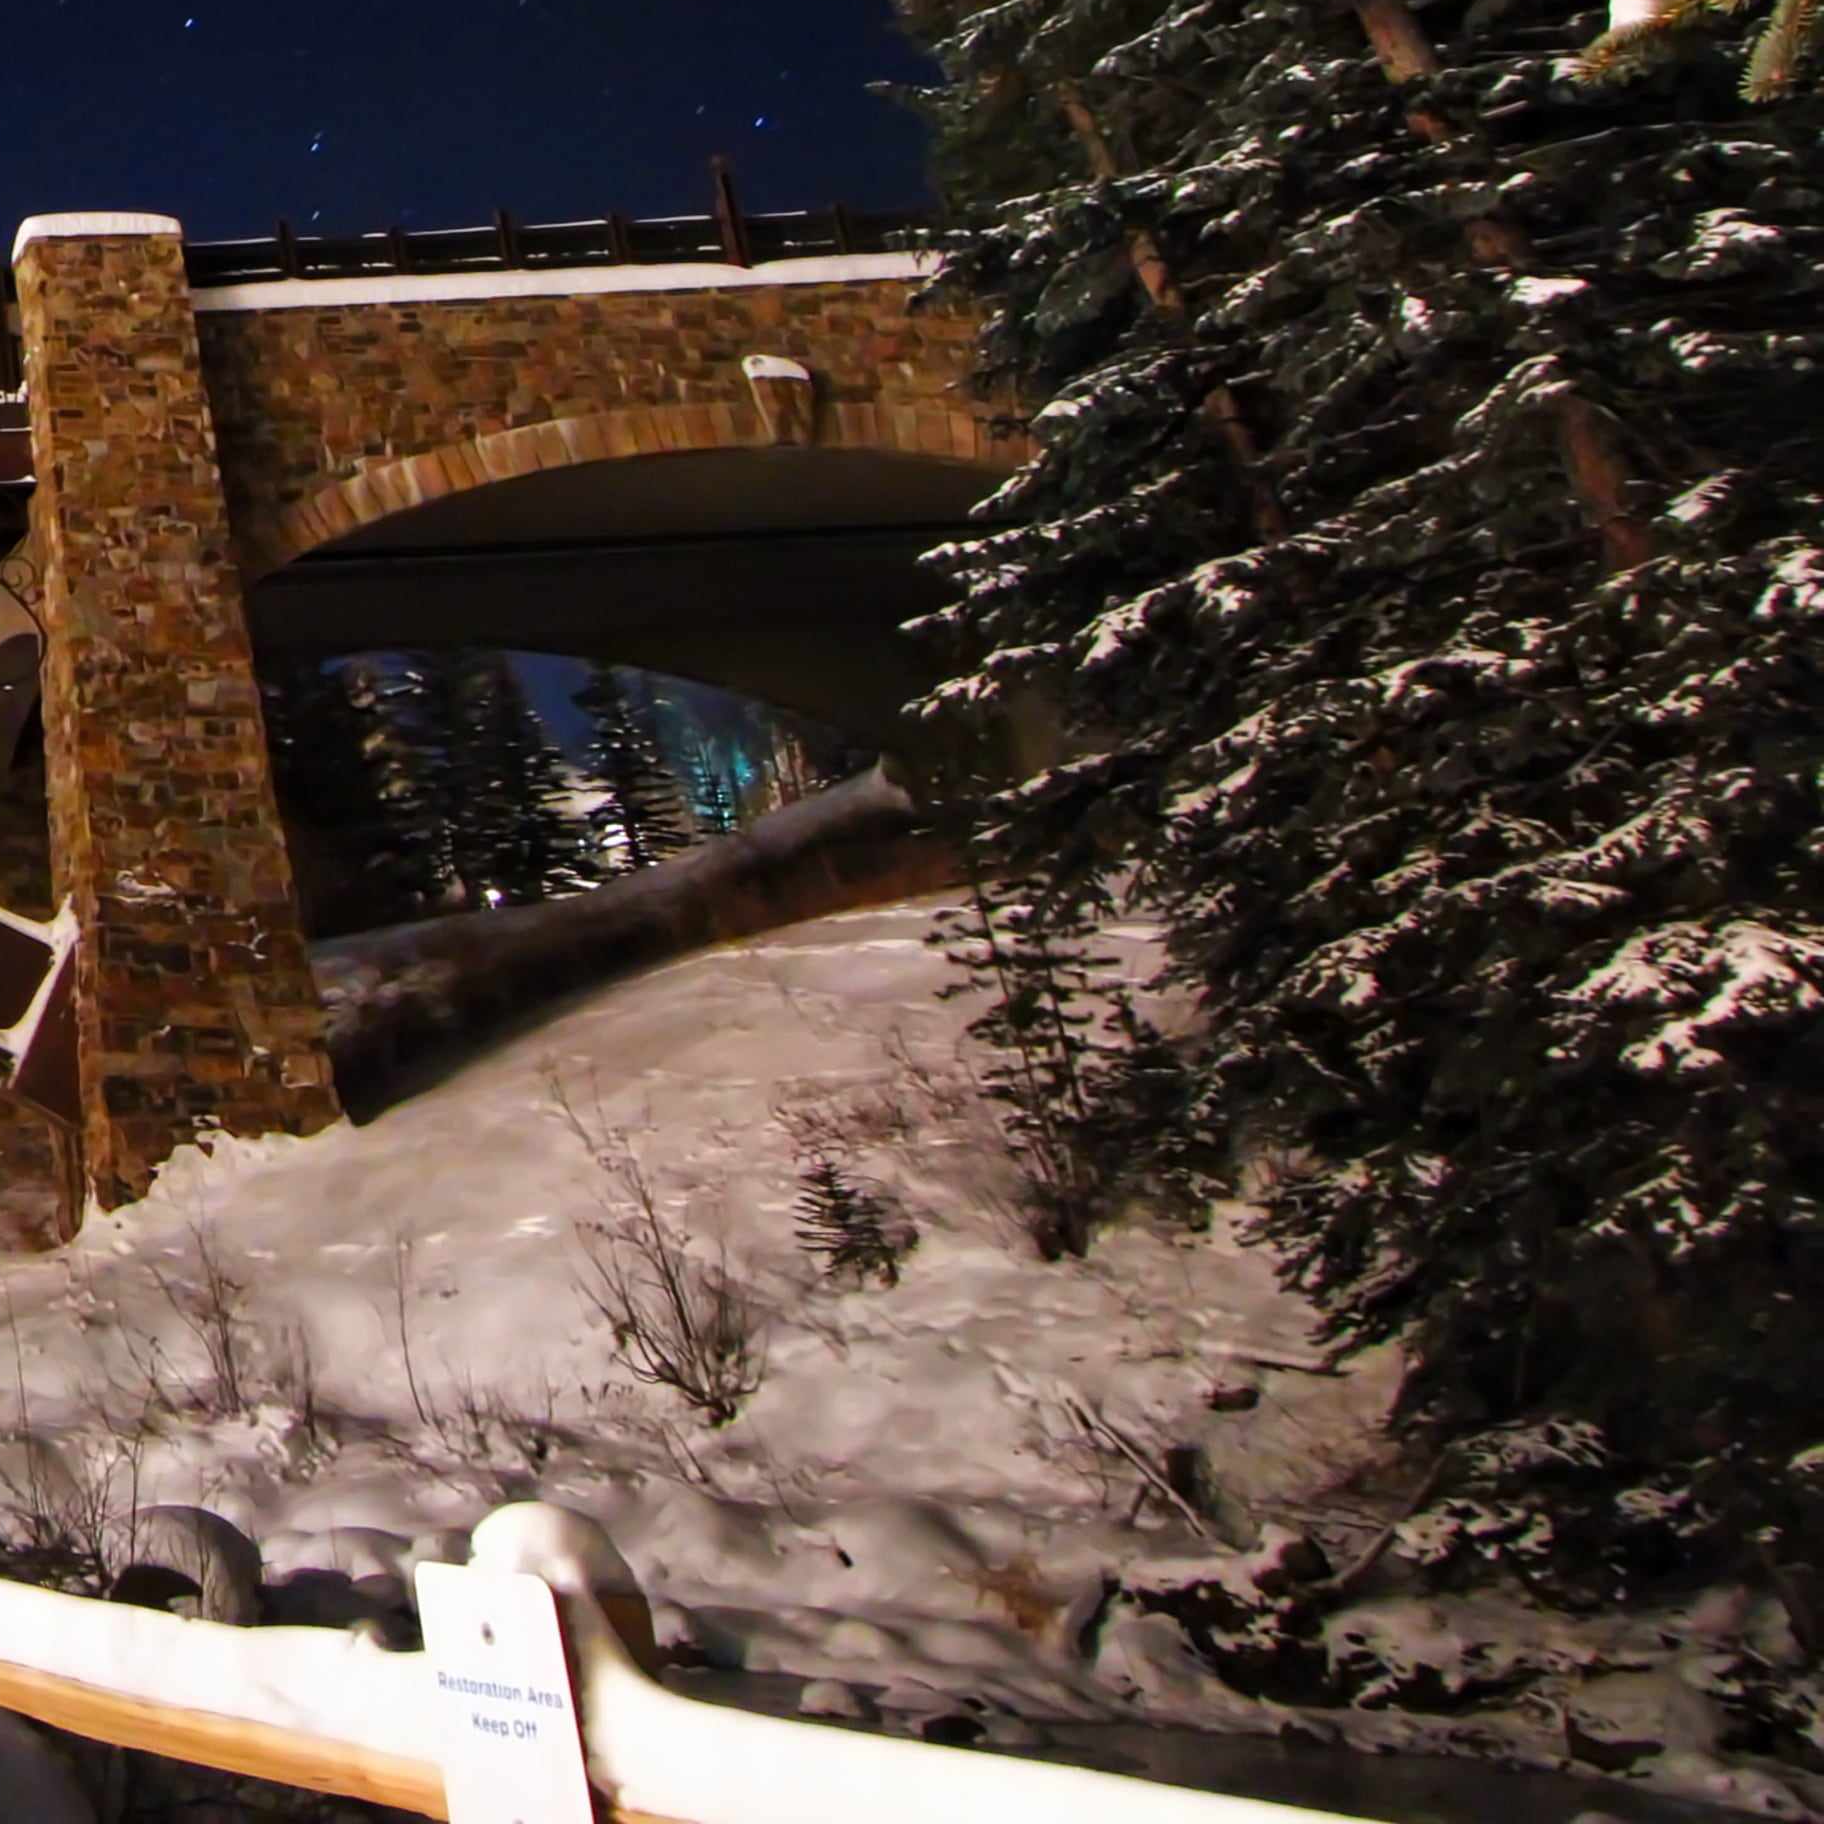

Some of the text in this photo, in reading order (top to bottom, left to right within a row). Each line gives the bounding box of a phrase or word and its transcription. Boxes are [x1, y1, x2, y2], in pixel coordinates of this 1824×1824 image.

[438, 1672, 563, 1708] Restoration Area
[472, 1714, 537, 1738] Keep Off
